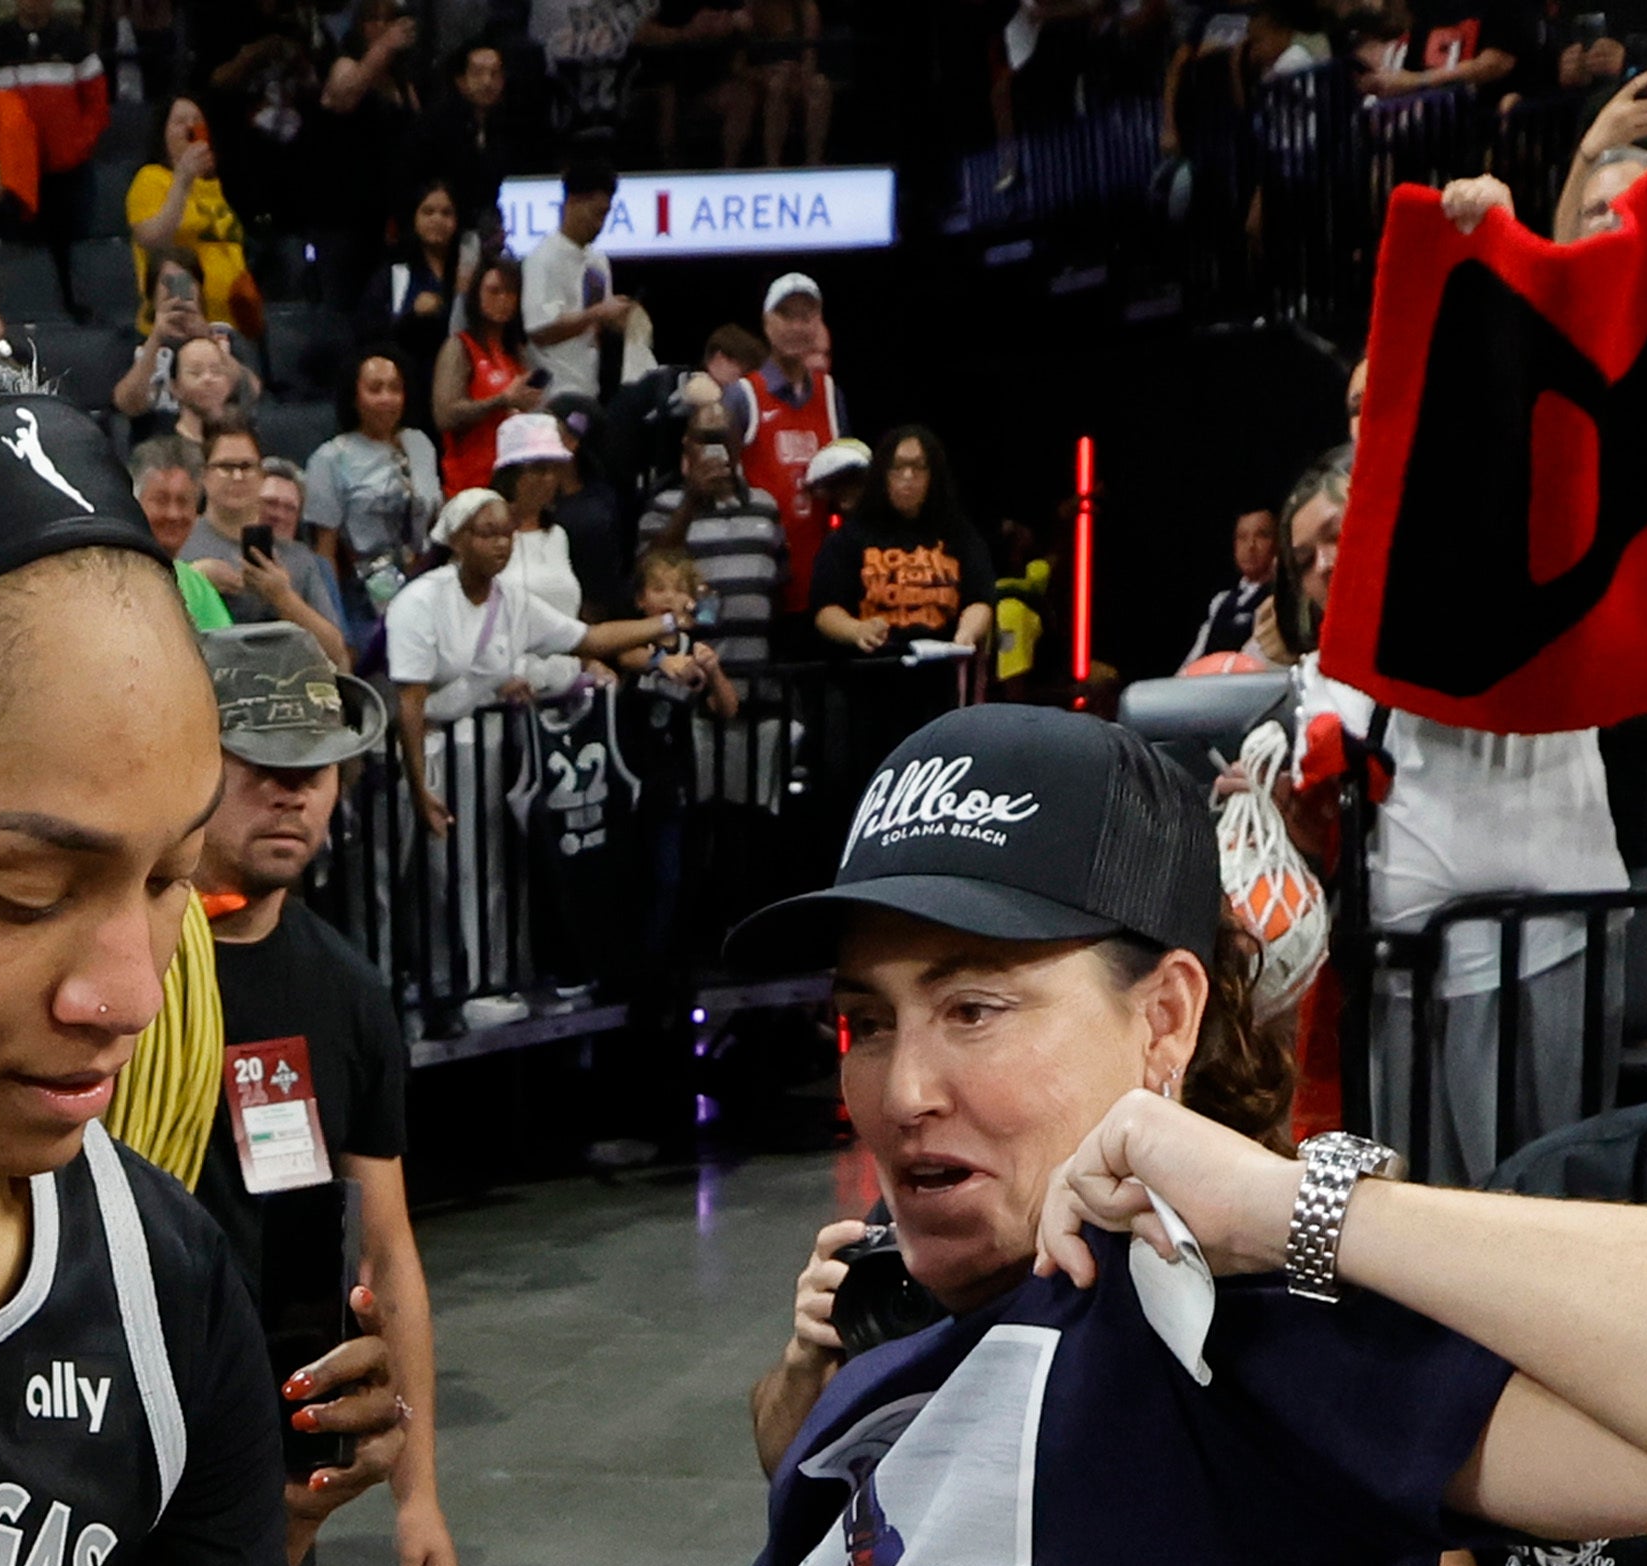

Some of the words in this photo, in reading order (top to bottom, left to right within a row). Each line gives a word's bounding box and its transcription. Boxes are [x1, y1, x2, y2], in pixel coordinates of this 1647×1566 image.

[504, 200, 634, 237] ULTA
[691, 194, 832, 231] ARENA
[547, 742, 608, 808] 22
[841, 757, 1041, 870] Pillbox
[881, 822, 946, 847] SOLANA
[950, 822, 1007, 847] BEACH
[234, 1056, 264, 1083] 20
[25, 1361, 112, 1433] ally
